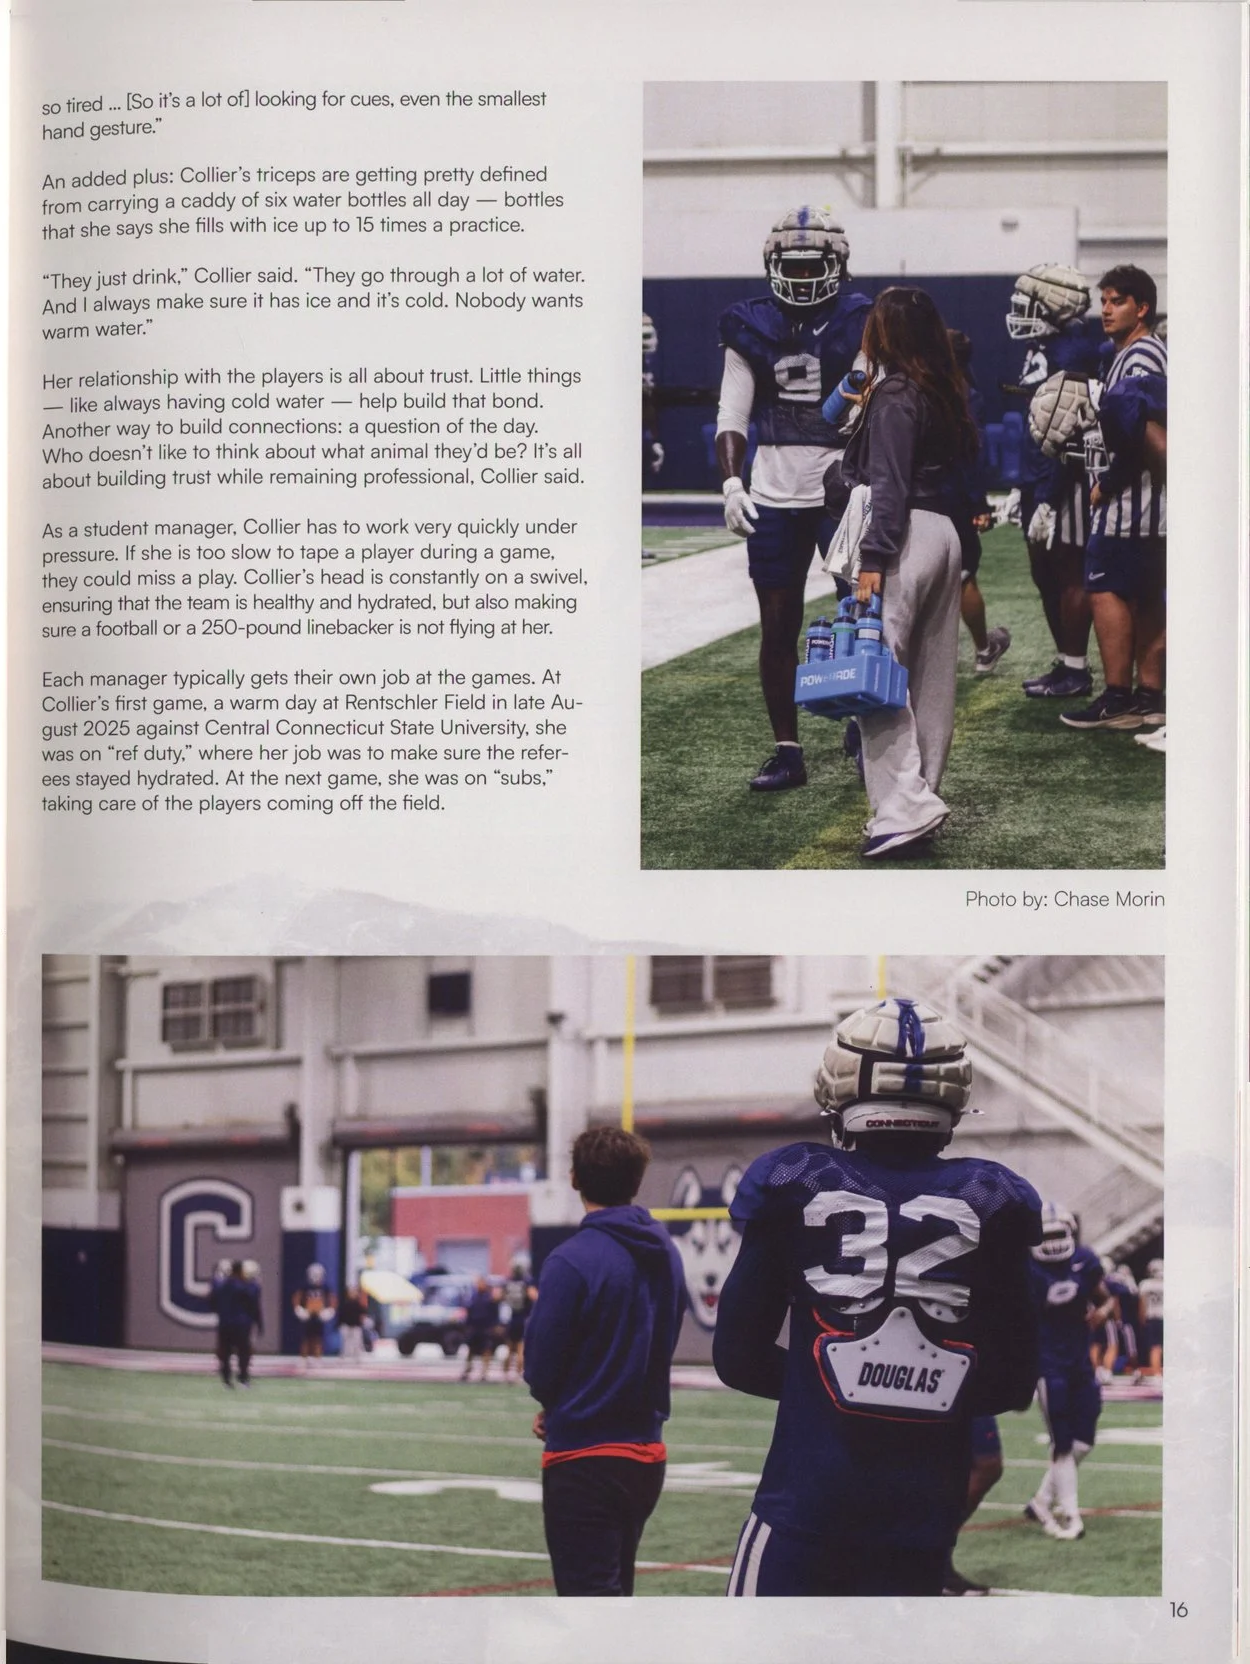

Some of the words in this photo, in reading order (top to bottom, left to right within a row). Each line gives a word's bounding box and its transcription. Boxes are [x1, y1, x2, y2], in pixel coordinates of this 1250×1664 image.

[42, 120, 85, 141] hand
[89, 116, 163, 142] gesture.”
[41, 173, 66, 191] An
[71, 168, 127, 189] added
[133, 167, 174, 190] plus:
[179, 165, 251, 184] Collier’s
[255, 165, 317, 187] triceps
[321, 170, 350, 183] are
[355, 165, 418, 187] getting
[423, 167, 475, 187] pretty
[479, 165, 548, 183] defined
[41, 325, 90, 341] warm
[94, 318, 154, 337] water.”
[42, 373, 74, 391] Her
[78, 368, 179, 389] relationship
[183, 367, 222, 385] with
[226, 367, 256, 385] the
[261, 367, 324, 389] players
[329, 367, 343, 384] is
[348, 366, 368, 384] all
[373, 367, 425, 384] about
[429, 368, 474, 384] trust.
[479, 366, 522, 384] Little
[526, 366, 582, 388] things
[774, 353, 822, 402] 9
[41, 522, 63, 540] As
[68, 526, 79, 539] a
[83, 519, 150, 538] student
[154, 522, 237, 540] manager,
[243, 517, 302, 535] Collier
[306, 517, 338, 535] has
[342, 519, 361, 535] to
[365, 517, 410, 535] work
[413, 522, 453, 539] very
[457, 517, 520, 539] quickly
[525, 517, 579, 535] under
[41, 721, 79, 742] gust
[82, 719, 131, 737] 2025
[135, 719, 200, 741] against
[204, 718, 270, 736] Central
[275, 718, 385, 736] Connecticut
[389, 718, 435, 736] State
[440, 718, 530, 740] University,
[535, 718, 567, 736] she
[41, 794, 93, 816] taking
[98, 798, 137, 812] care
[141, 794, 160, 812] of
[164, 794, 193, 812] the
[198, 793, 262, 816] players
[266, 794, 334, 816] coming
[339, 793, 364, 811] off
[368, 793, 398, 811] the
[401, 793, 446, 811] field.
[966, 890, 1016, 907] Photo
[1023, 890, 1047, 911] by:
[1054, 890, 1109, 907] Chase
[1117, 891, 1165, 907] Morin
[866, 1118, 940, 1129] CONNECTICUT
[803, 1190, 981, 1307] 32
[857, 1361, 944, 1394] DOUGLAS
[1169, 1601, 1188, 1618] 16
